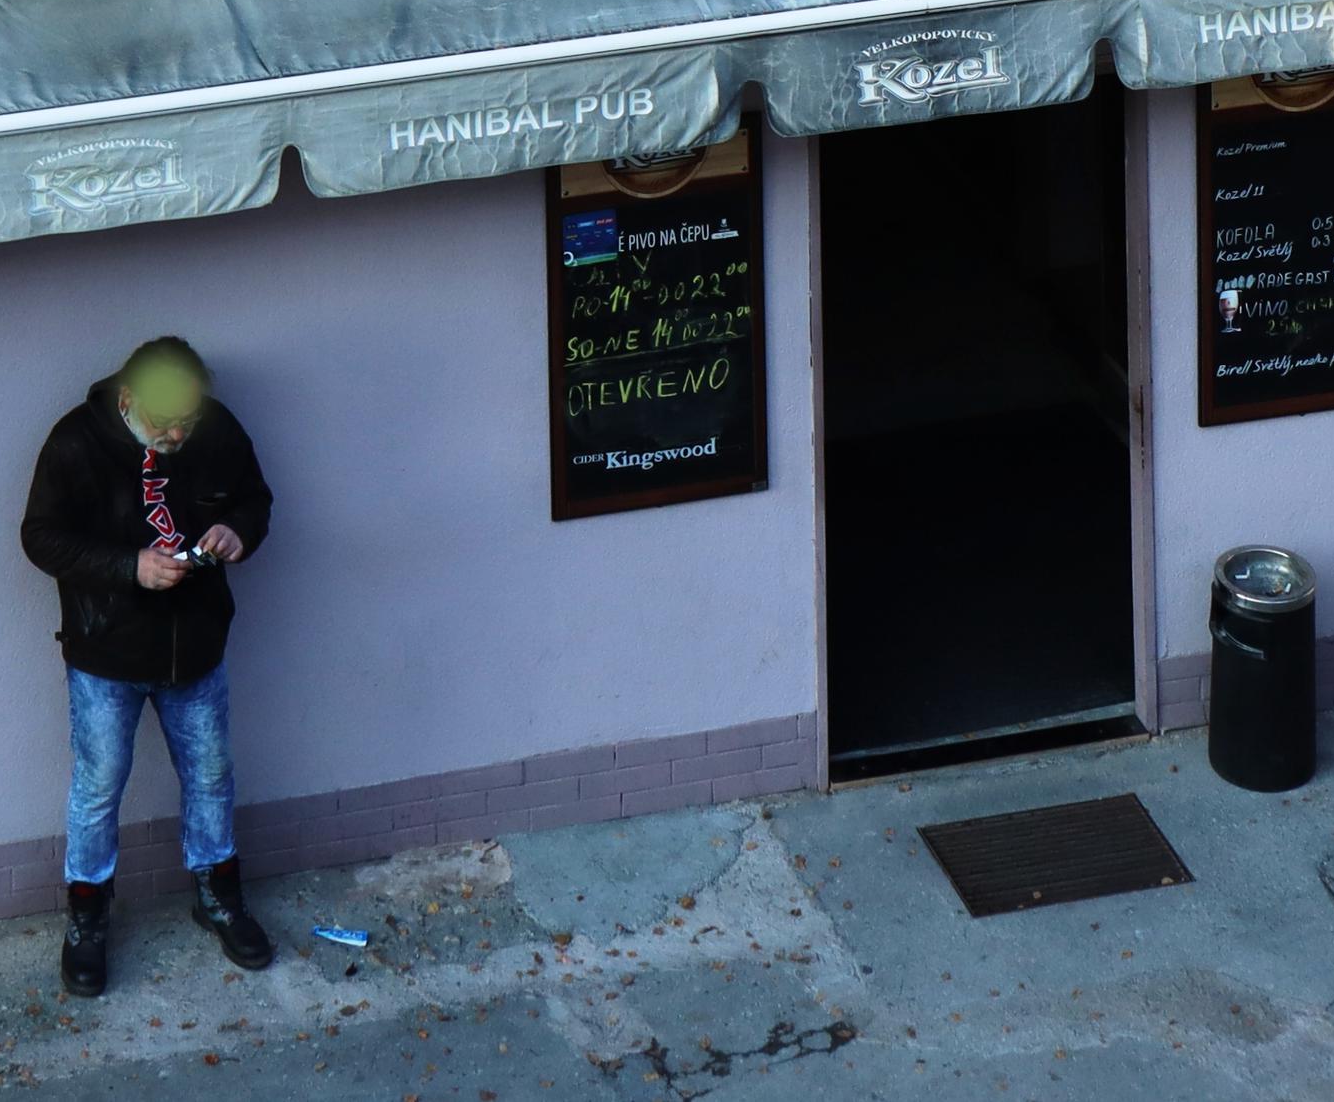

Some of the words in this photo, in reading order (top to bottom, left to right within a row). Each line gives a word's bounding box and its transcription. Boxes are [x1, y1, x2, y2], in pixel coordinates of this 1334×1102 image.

[851, 45, 1011, 107] Kozel
[390, 98, 564, 150] HANIBAL
[574, 87, 654, 124] PUB
[1216, 143, 1245, 157] Kozel
[1245, 139, 1288, 154] Premium
[24, 152, 190, 217] Kozel
[1215, 183, 1253, 202] Kozel
[628, 231, 656, 251] PIVO
[659, 228, 677, 247] NA
[680, 222, 710, 243] ČEPU
[1216, 223, 1276, 249] KOFOLA
[1216, 246, 1254, 263] Kozel
[1254, 241, 1294, 263] Světlý
[1216, 360, 1253, 377] Birell
[573, 453, 605, 466] CIDER
[605, 437, 717, 471] Kingswood
